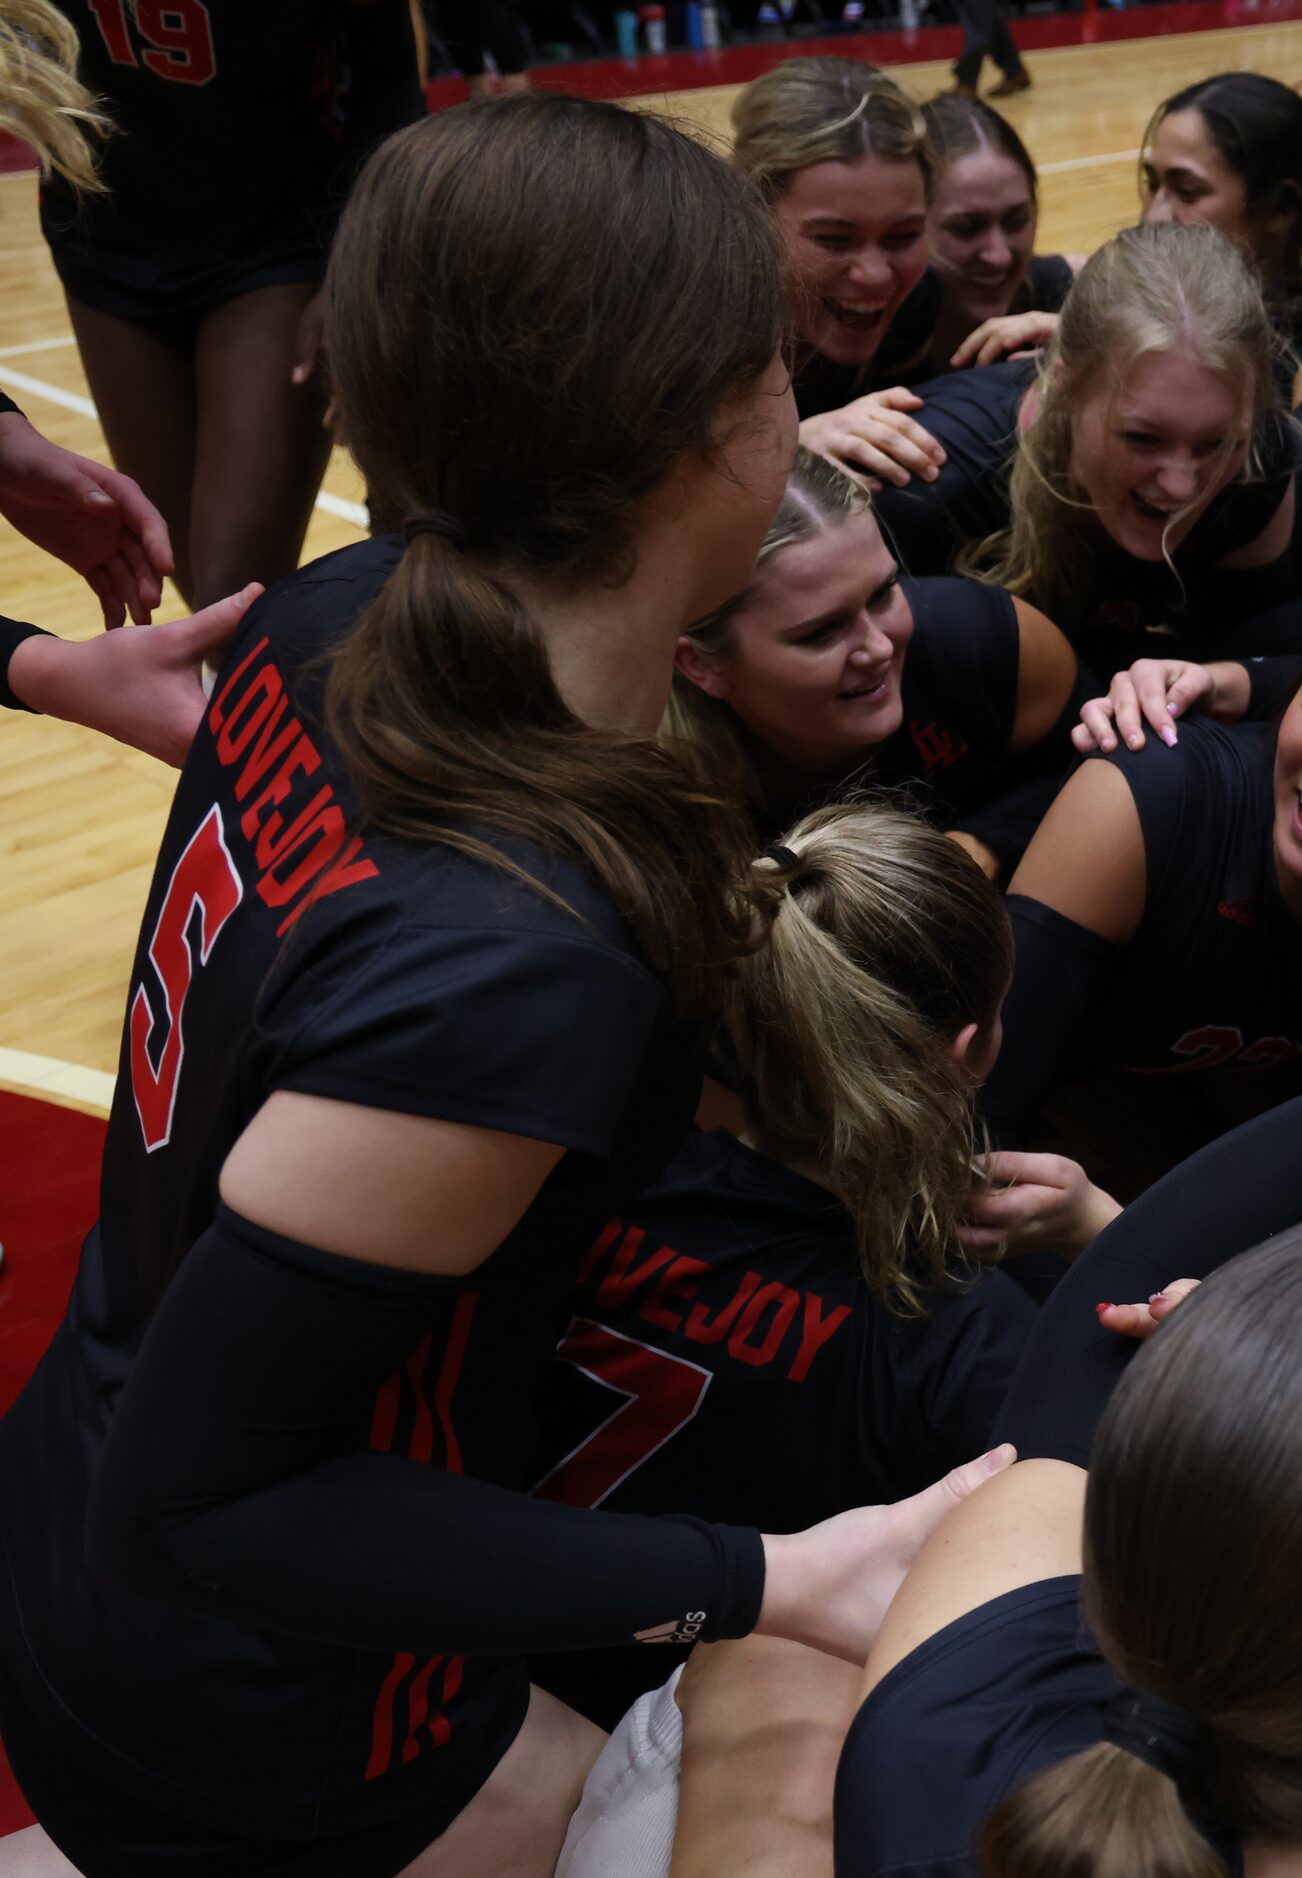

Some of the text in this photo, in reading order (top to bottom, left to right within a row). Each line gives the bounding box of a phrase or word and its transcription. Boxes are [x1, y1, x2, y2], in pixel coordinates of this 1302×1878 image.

[209, 636, 381, 938] LOVEJOY
[130, 801, 244, 1154] 5
[526, 1316, 715, 1511] 7
